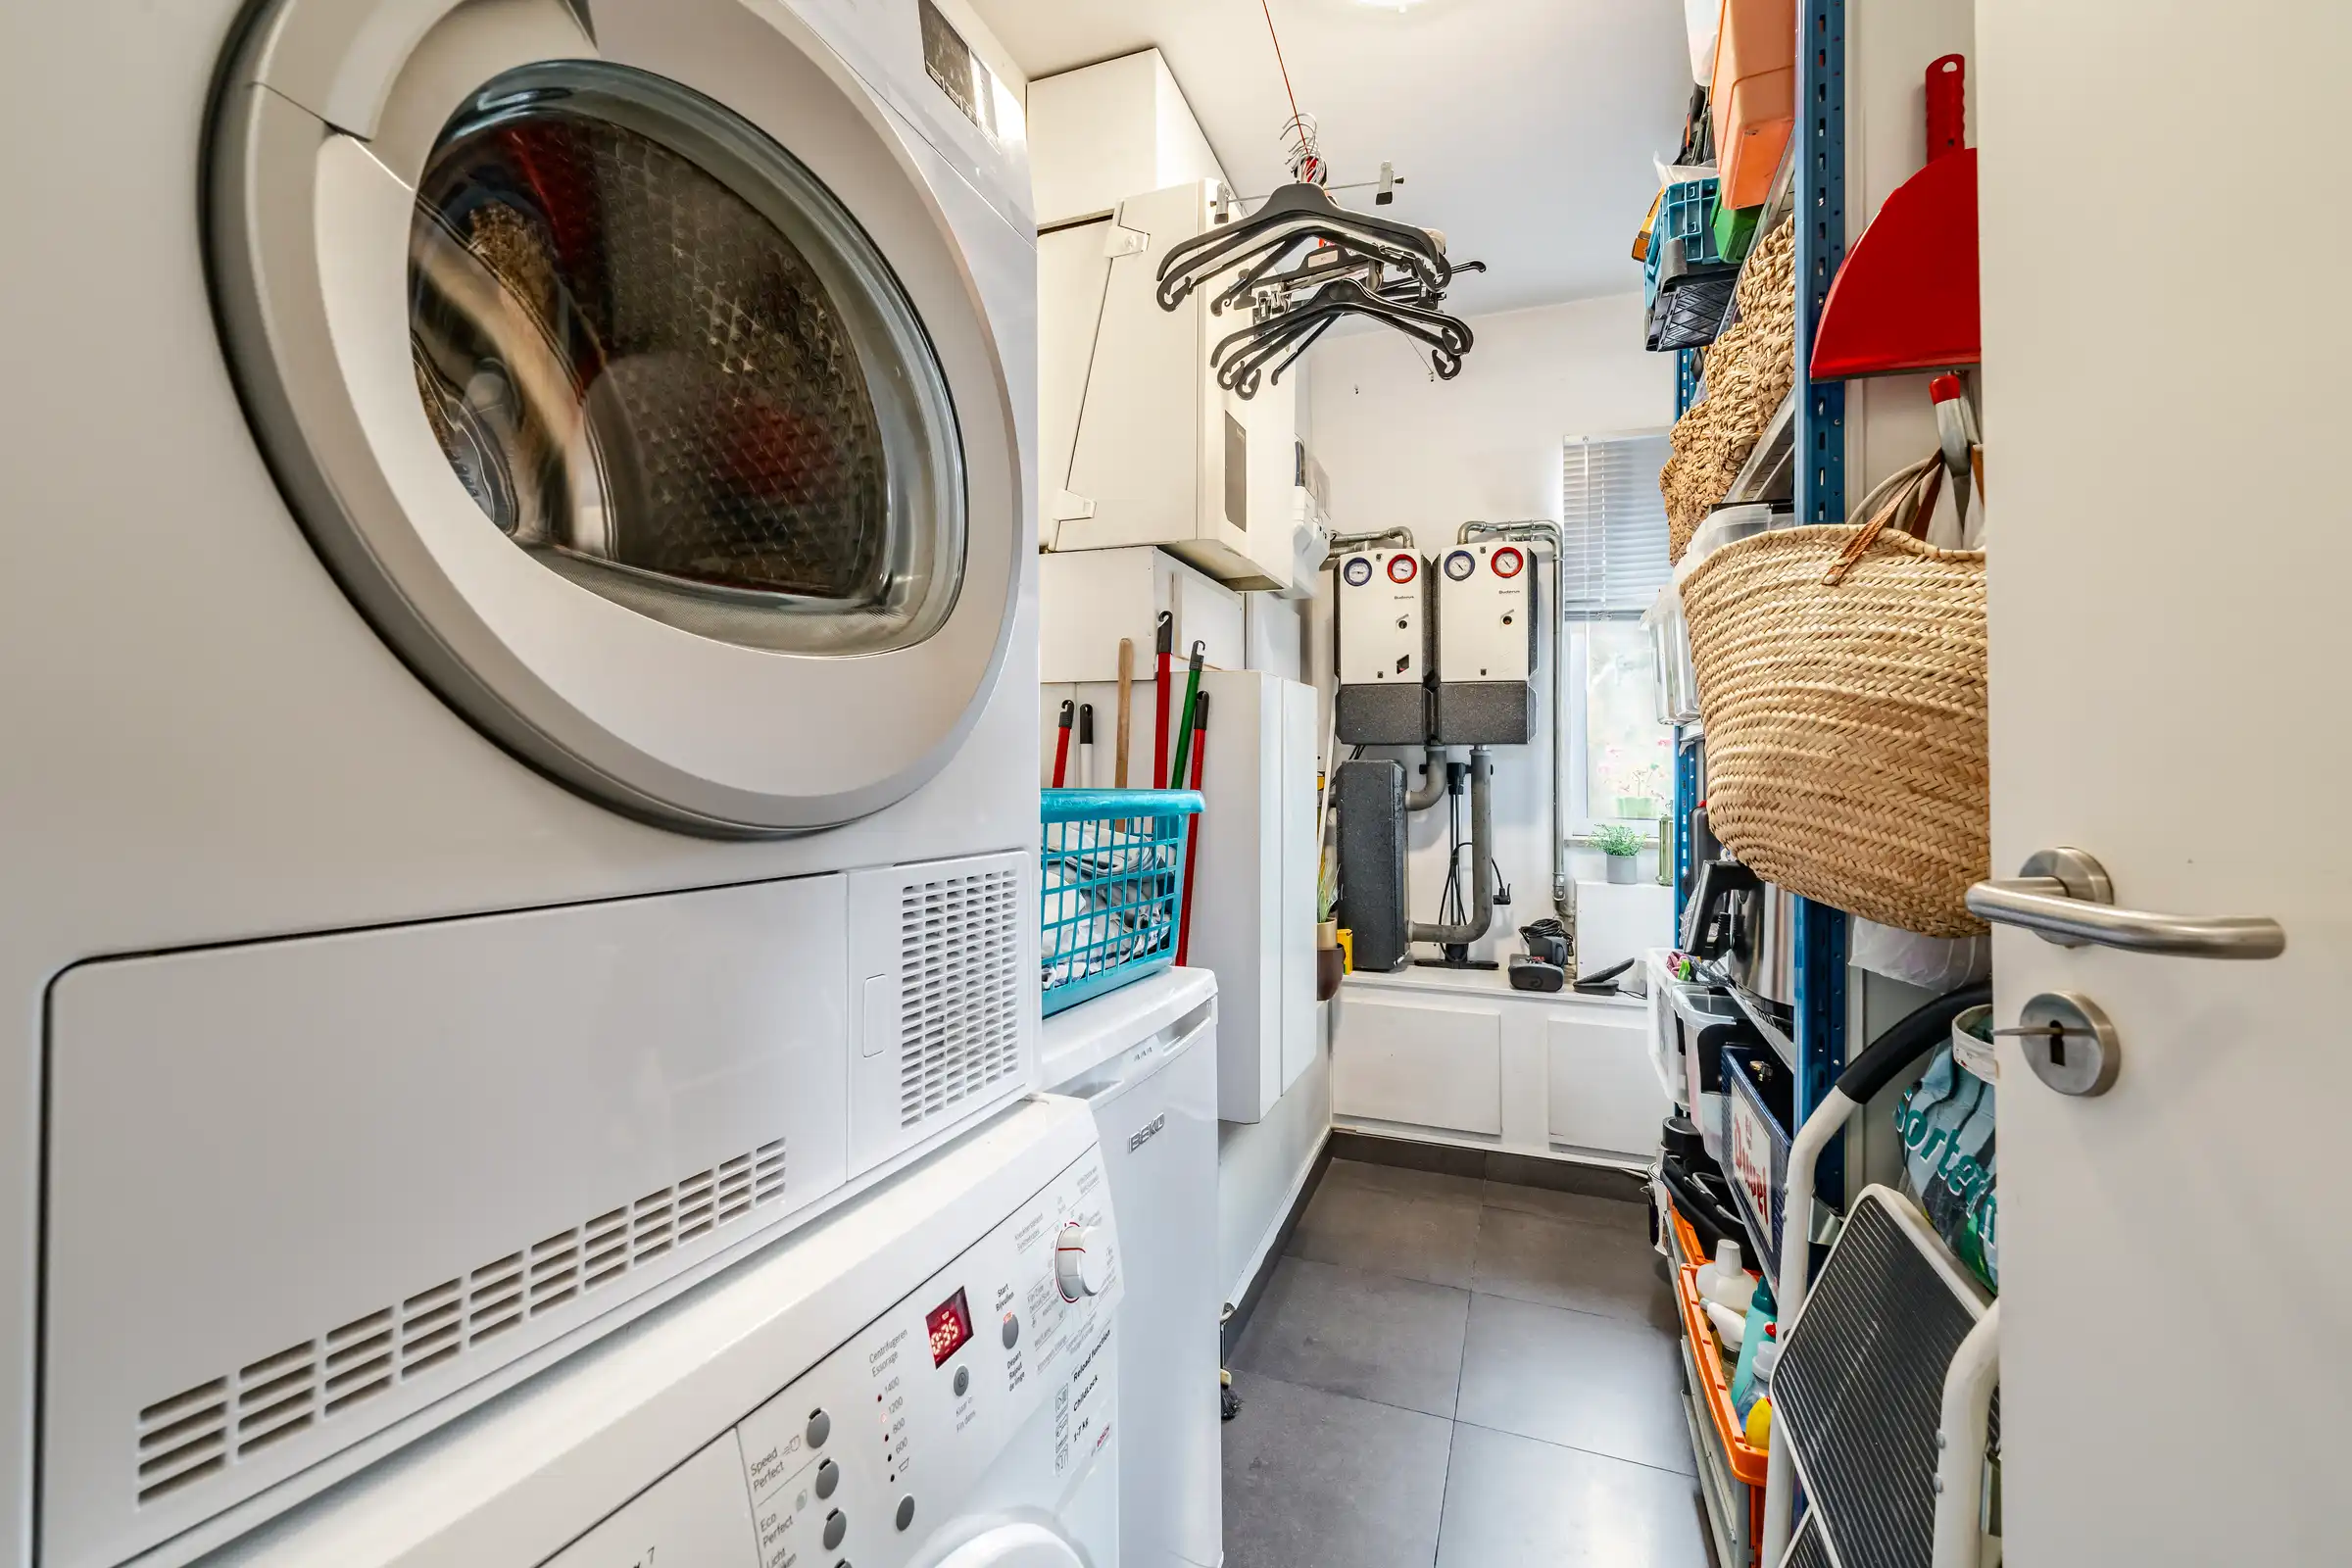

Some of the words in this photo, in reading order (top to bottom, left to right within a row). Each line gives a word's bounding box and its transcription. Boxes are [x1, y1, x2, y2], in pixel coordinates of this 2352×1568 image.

[1128, 1112, 1165, 1153] BEKO
[997, 1283, 1009, 1298] Start
[996, 1291, 1014, 1311] Bijvullen
[931, 1316, 958, 1355] 0:35
[869, 1328, 907, 1364] Centrifugeren
[1073, 1353, 1092, 1383] Reload
[1091, 1329, 1110, 1359] function
[871, 1350, 899, 1378] Essorage
[1008, 1361, 1023, 1381] Rajout
[884, 1376, 900, 1394] 1400
[1008, 1381, 1015, 1392] de
[1014, 1371, 1025, 1388] linge
[888, 1396, 904, 1414] 1200
[893, 1417, 906, 1435] 800
[896, 1437, 908, 1454] 600
[750, 1446, 778, 1476] Speed
[753, 1461, 785, 1493] Perfect
[760, 1513, 777, 1533] Eco
[762, 1515, 794, 1548] Perfect
[647, 1546, 655, 1565] 7
